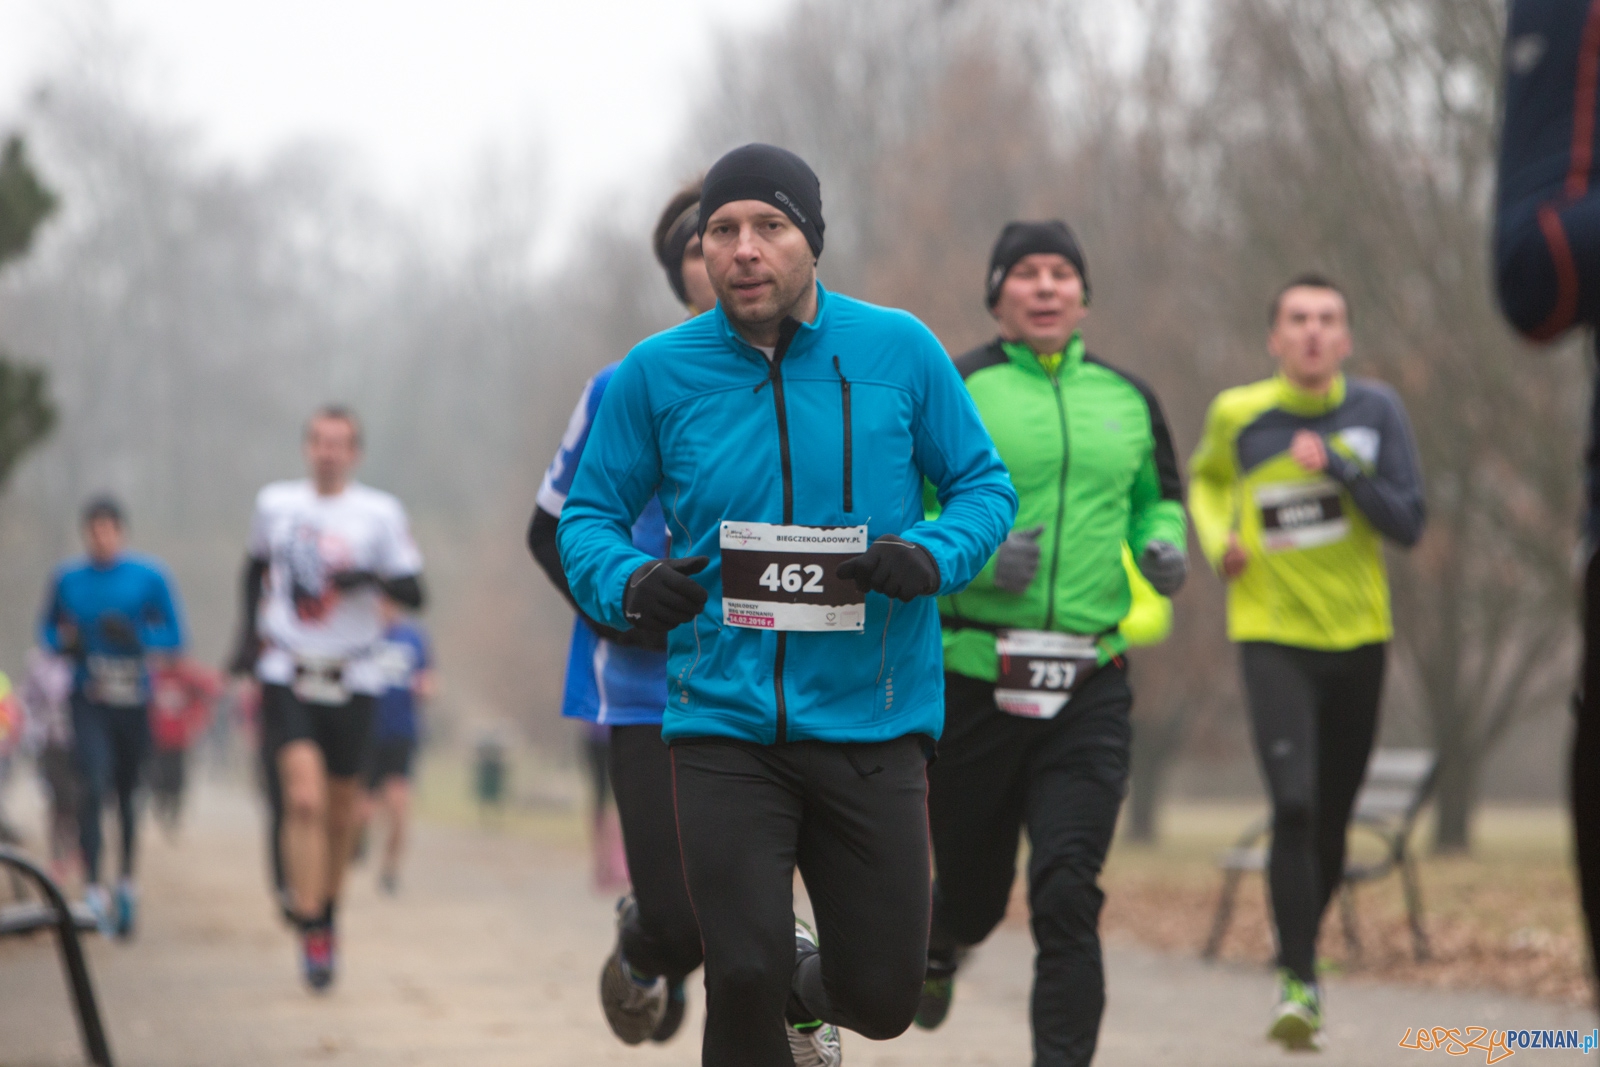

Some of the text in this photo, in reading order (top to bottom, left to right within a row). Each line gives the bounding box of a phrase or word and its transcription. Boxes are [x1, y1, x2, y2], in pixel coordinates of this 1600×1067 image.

[776, 535, 861, 543] BIEGCZEKOLADOWY.PL
[759, 563, 824, 593] 462
[1028, 661, 1076, 690] 757
